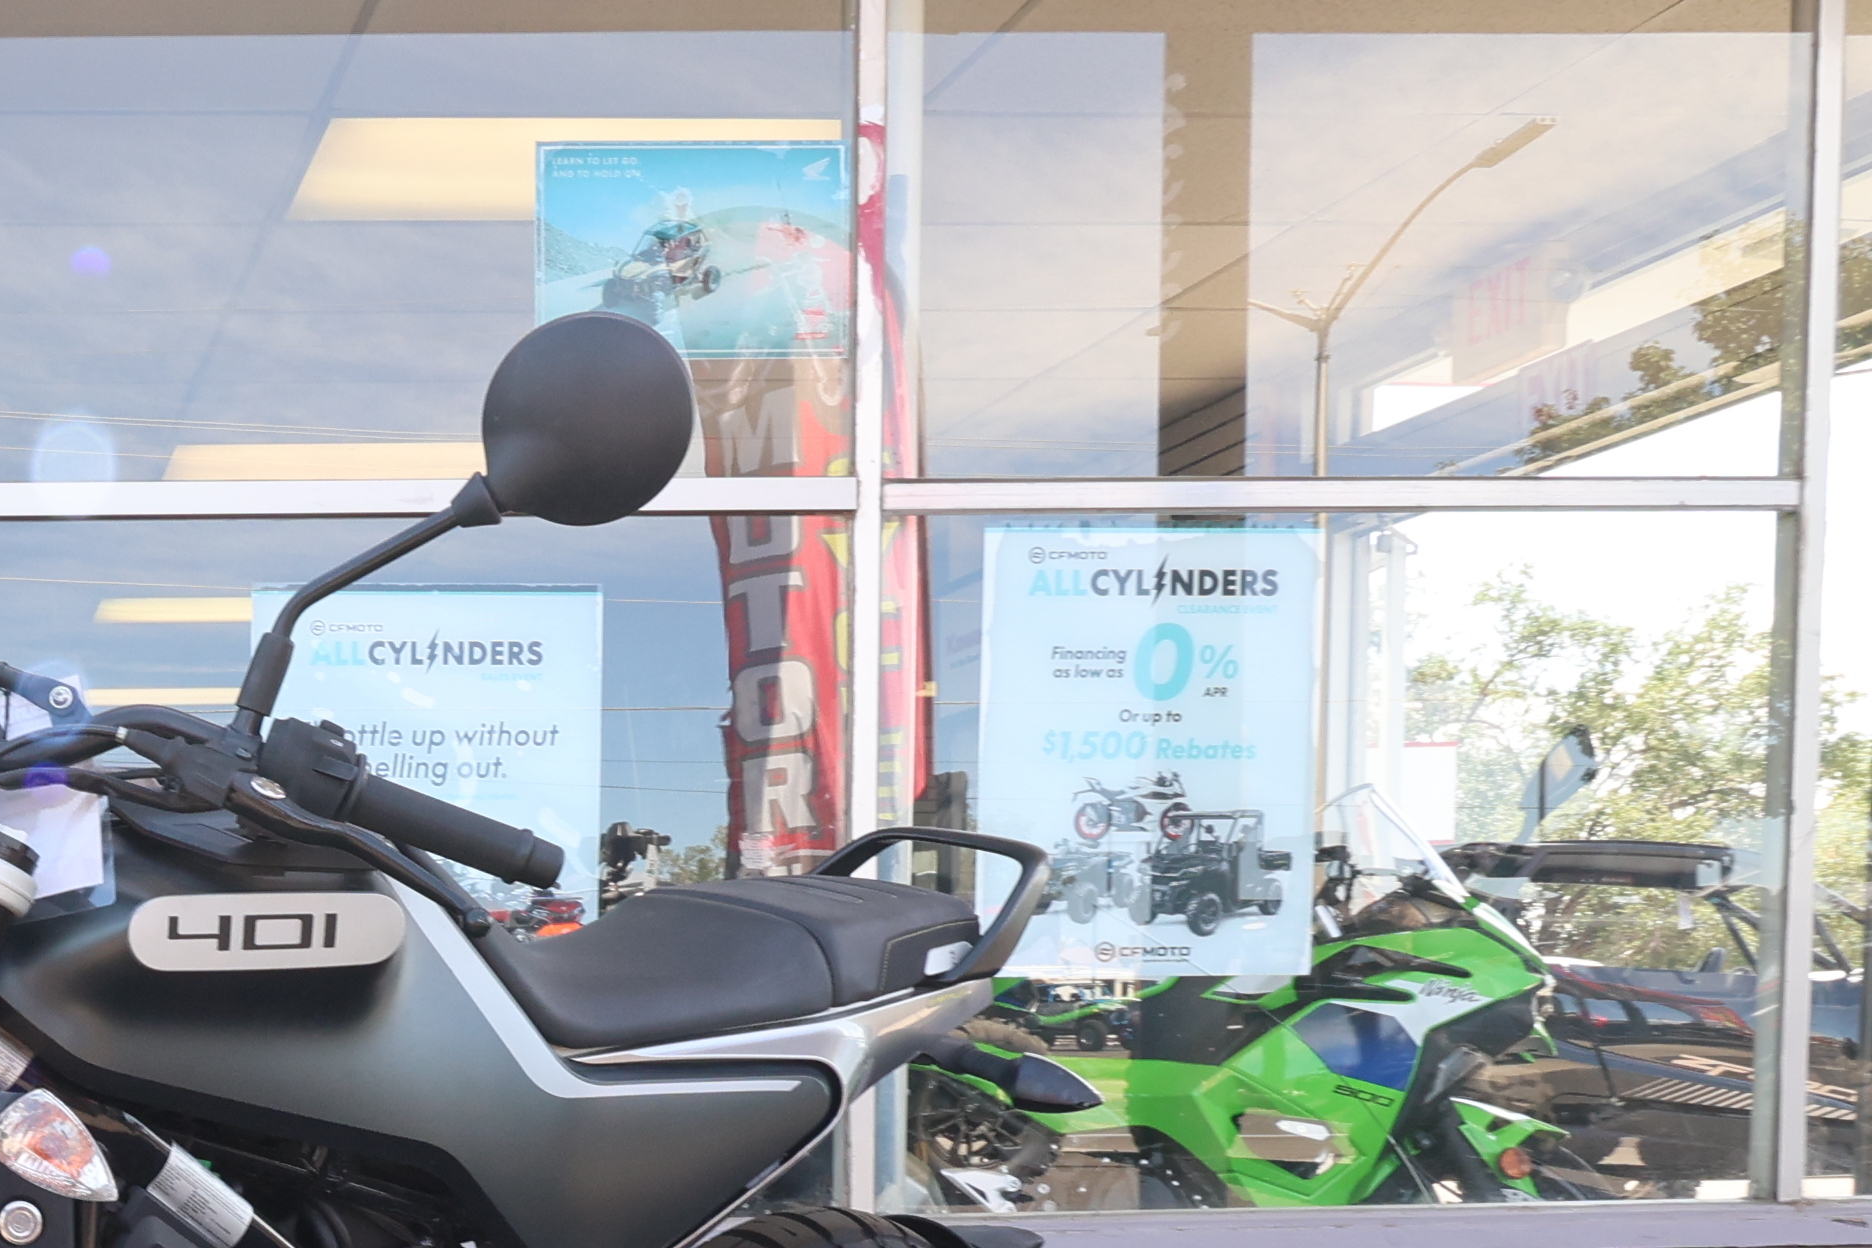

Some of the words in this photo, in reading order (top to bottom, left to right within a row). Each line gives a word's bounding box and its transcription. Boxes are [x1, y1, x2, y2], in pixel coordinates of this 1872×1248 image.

[1049, 551, 1107, 560] CFMOTO
[329, 624, 384, 632] CFMOTO
[1050, 646, 1127, 664] Financing
[1053, 667, 1071, 678] as
[1074, 664, 1104, 678] low
[1106, 667, 1124, 678] as
[1202, 687, 1229, 697] APR
[1119, 708, 1139, 723] Or
[1142, 711, 1162, 726] up
[1165, 710, 1183, 723] to
[412, 729, 446, 754] up
[455, 721, 560, 747] without
[1043, 729, 1149, 763] $1,500
[1156, 736, 1258, 760] Rebates
[456, 757, 507, 779] out.
[167, 913, 338, 951] 401
[1118, 946, 1191, 957] CFMOTO
[1418, 977, 1481, 1004] Ninja
